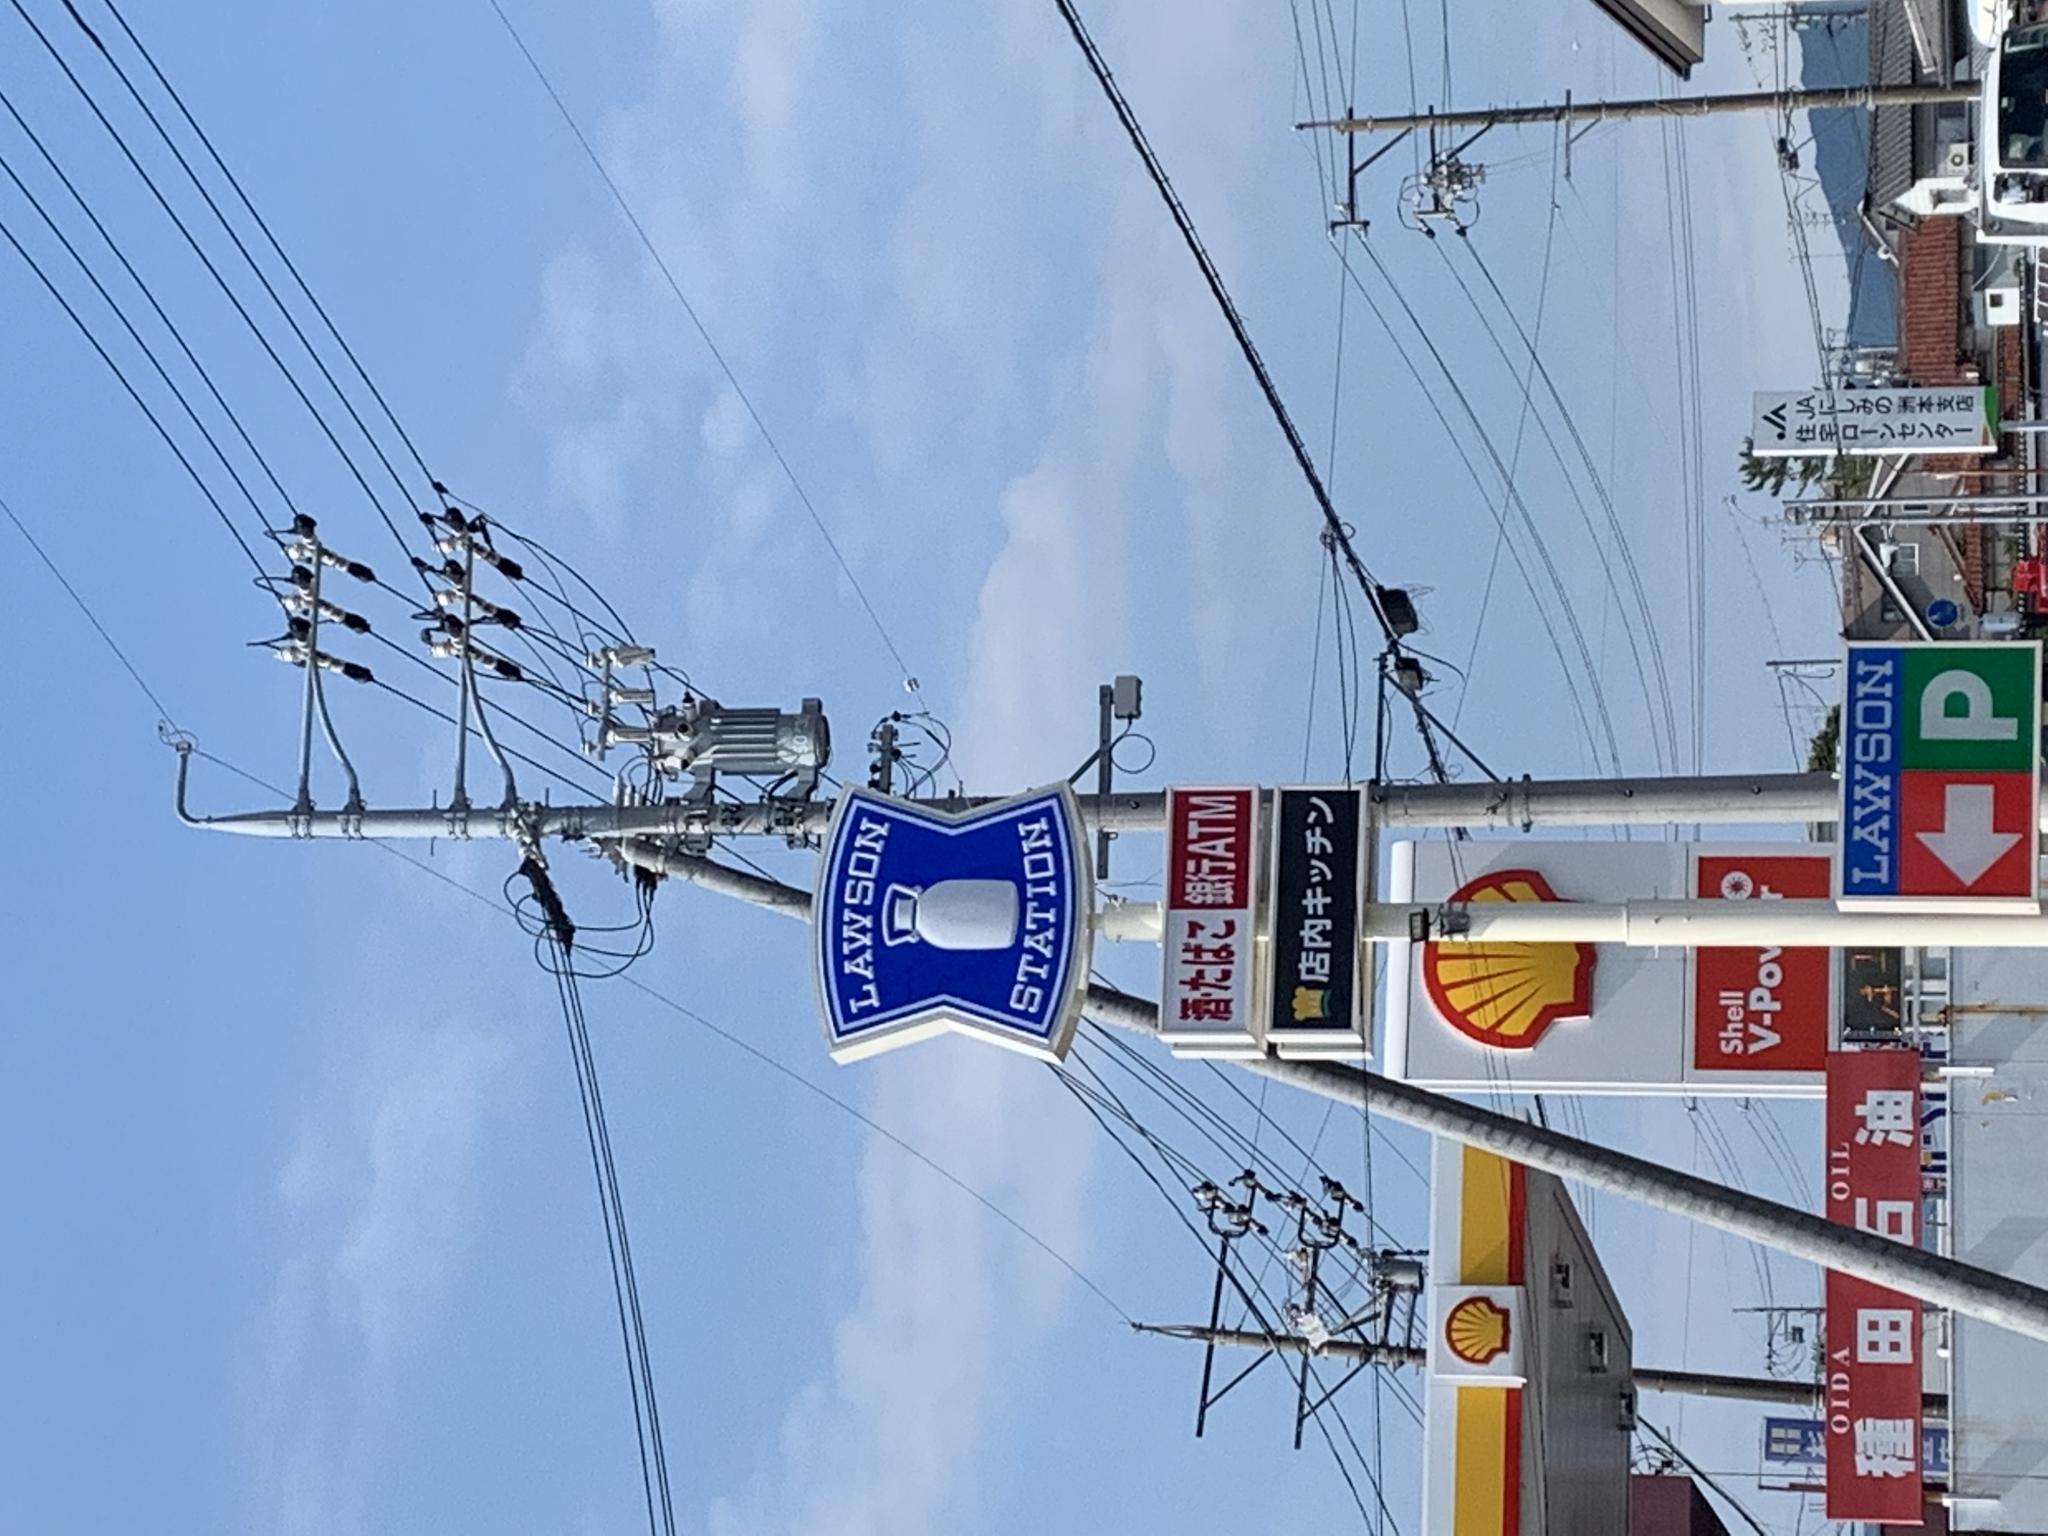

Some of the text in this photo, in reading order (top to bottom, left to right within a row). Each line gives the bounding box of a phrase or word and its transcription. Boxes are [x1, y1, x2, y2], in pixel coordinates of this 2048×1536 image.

[1796, 422, 1974, 443] 住宅ローンセンター
[1851, 659, 1893, 884] LAWSON
[1919, 669, 2018, 740] P
[843, 817, 890, 1013] LAWSON
[1010, 817, 1056, 1013] STATION
[1184, 795, 1237, 904] 銀行ATM
[1298, 796, 1334, 982] 店内キッチン
[1719, 990, 1745, 1054] Shell
[1748, 884, 1783, 1054] V-Por
[1831, 1141, 1850, 1434] OIDA OIL
